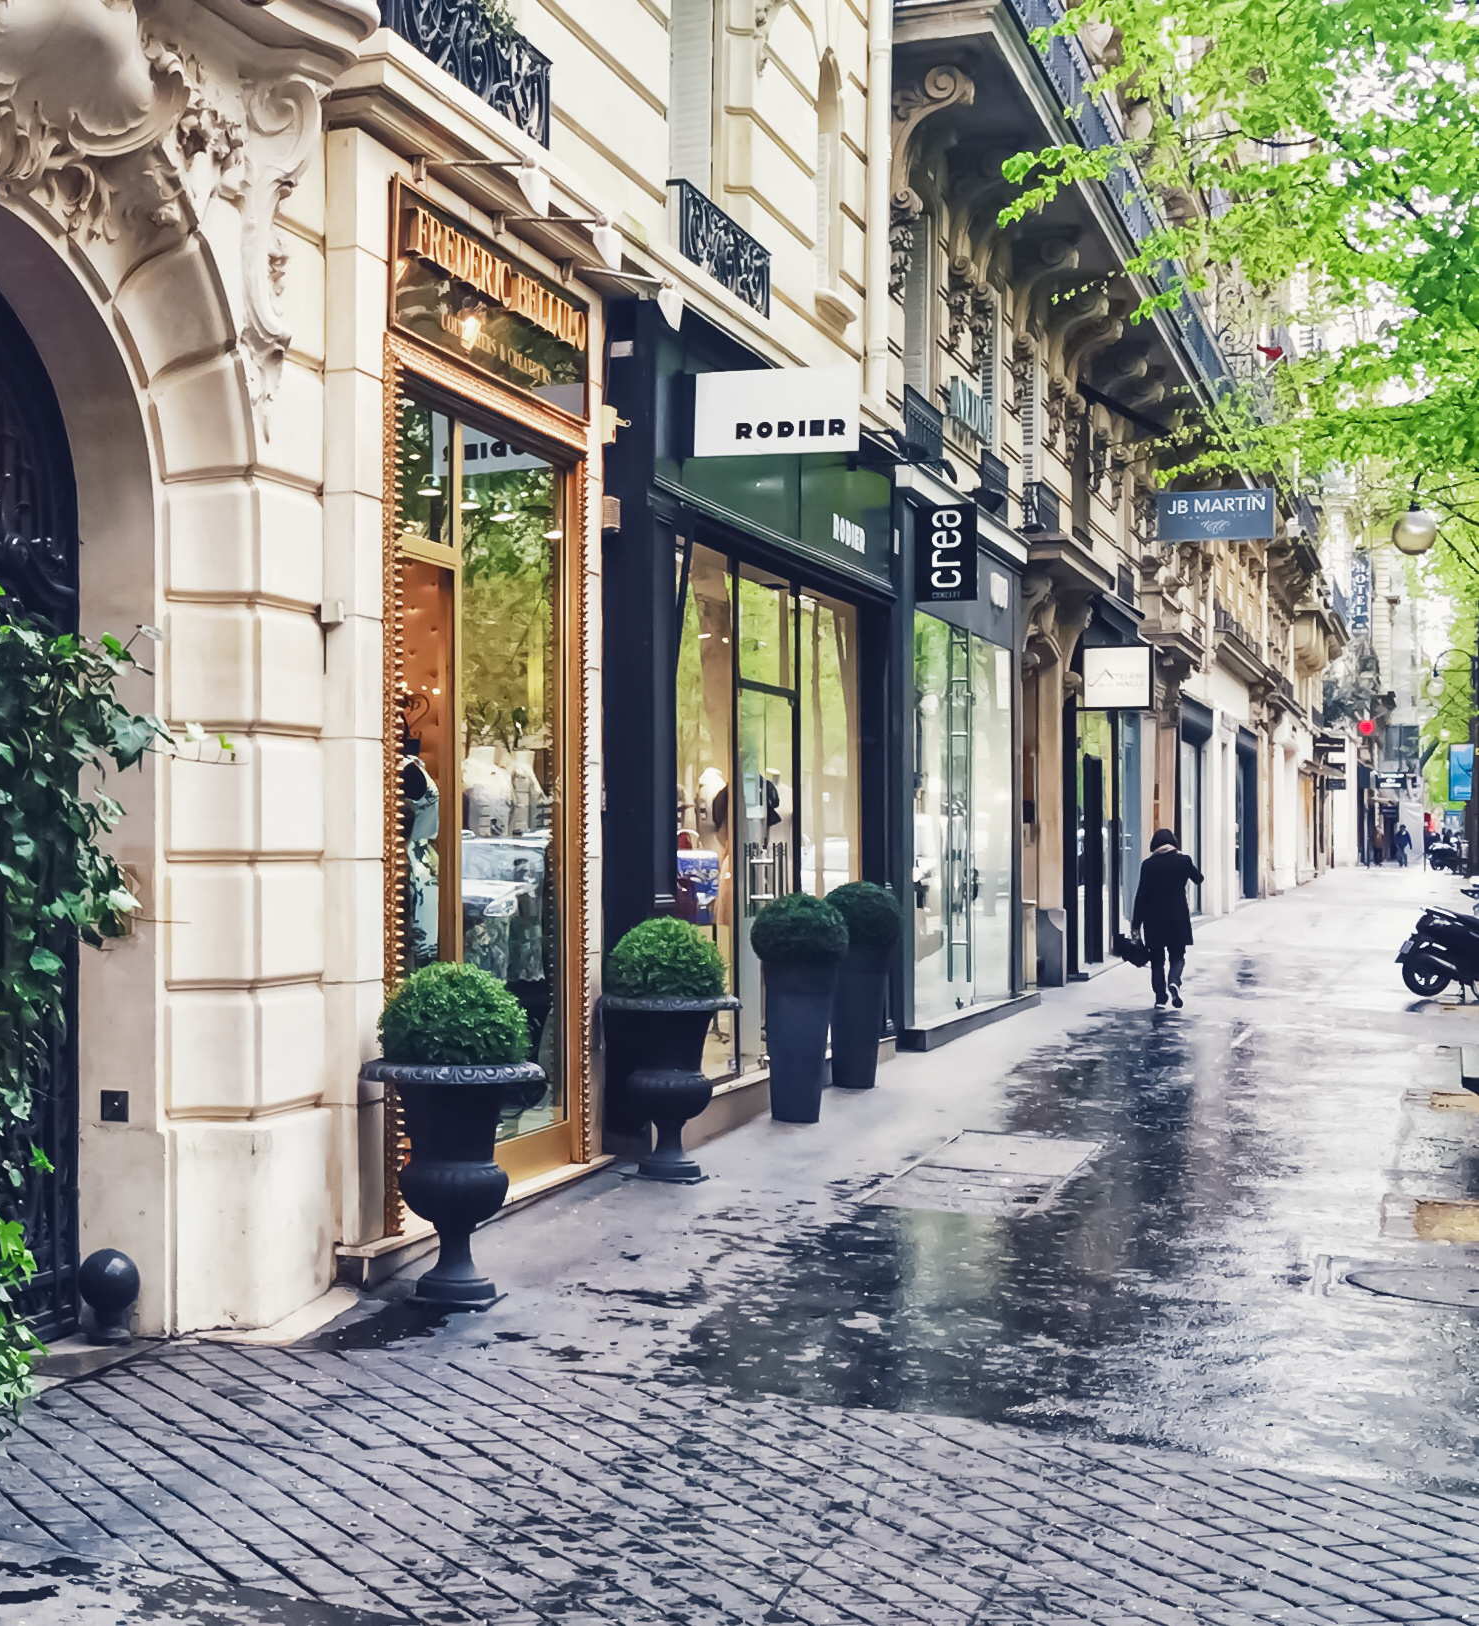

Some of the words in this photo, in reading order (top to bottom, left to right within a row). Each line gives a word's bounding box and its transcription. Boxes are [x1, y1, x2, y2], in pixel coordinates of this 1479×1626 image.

[735, 418, 845, 439] RODIER
[1167, 499, 1188, 515] JB
[1194, 496, 1265, 513] MARTIN
[833, 512, 865, 554] RODIER
[930, 510, 962, 588] crea
